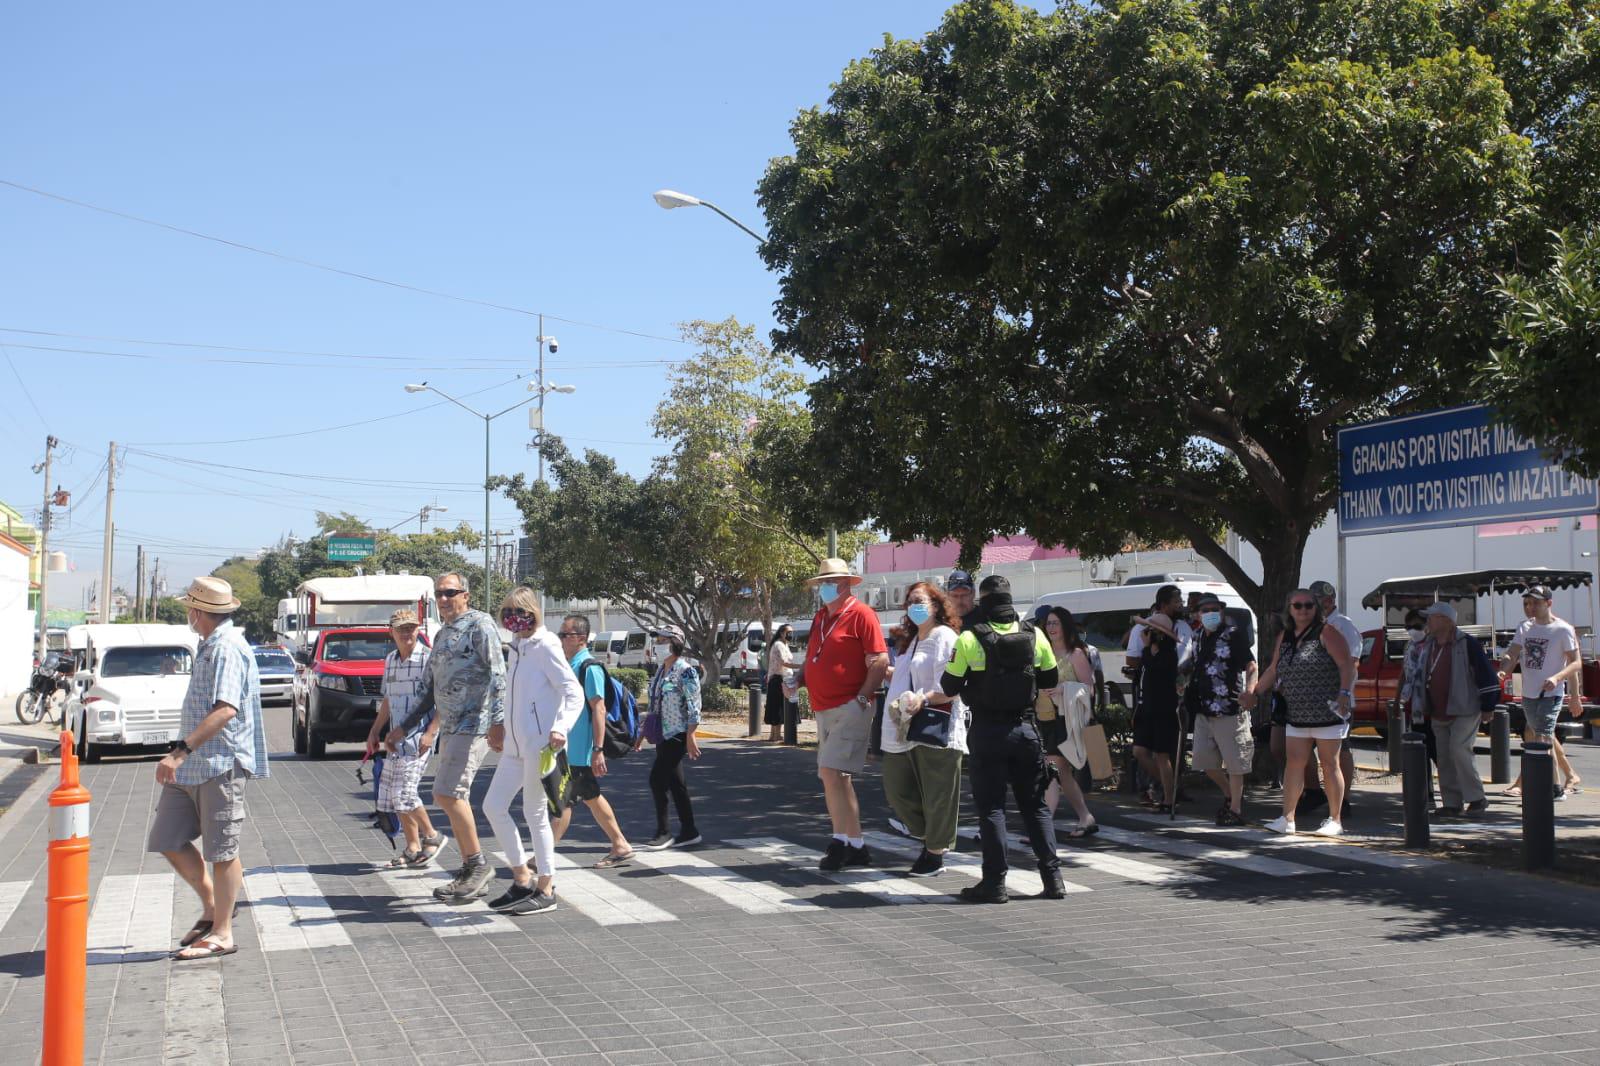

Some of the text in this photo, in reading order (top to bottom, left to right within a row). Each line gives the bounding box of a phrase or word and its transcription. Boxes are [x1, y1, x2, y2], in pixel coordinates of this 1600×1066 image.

[1352, 422, 1536, 475] GRACIAS POR VISITAR MAZA
[1343, 464, 1592, 519] THANK YOU FOR VISITING MAZATLAN
